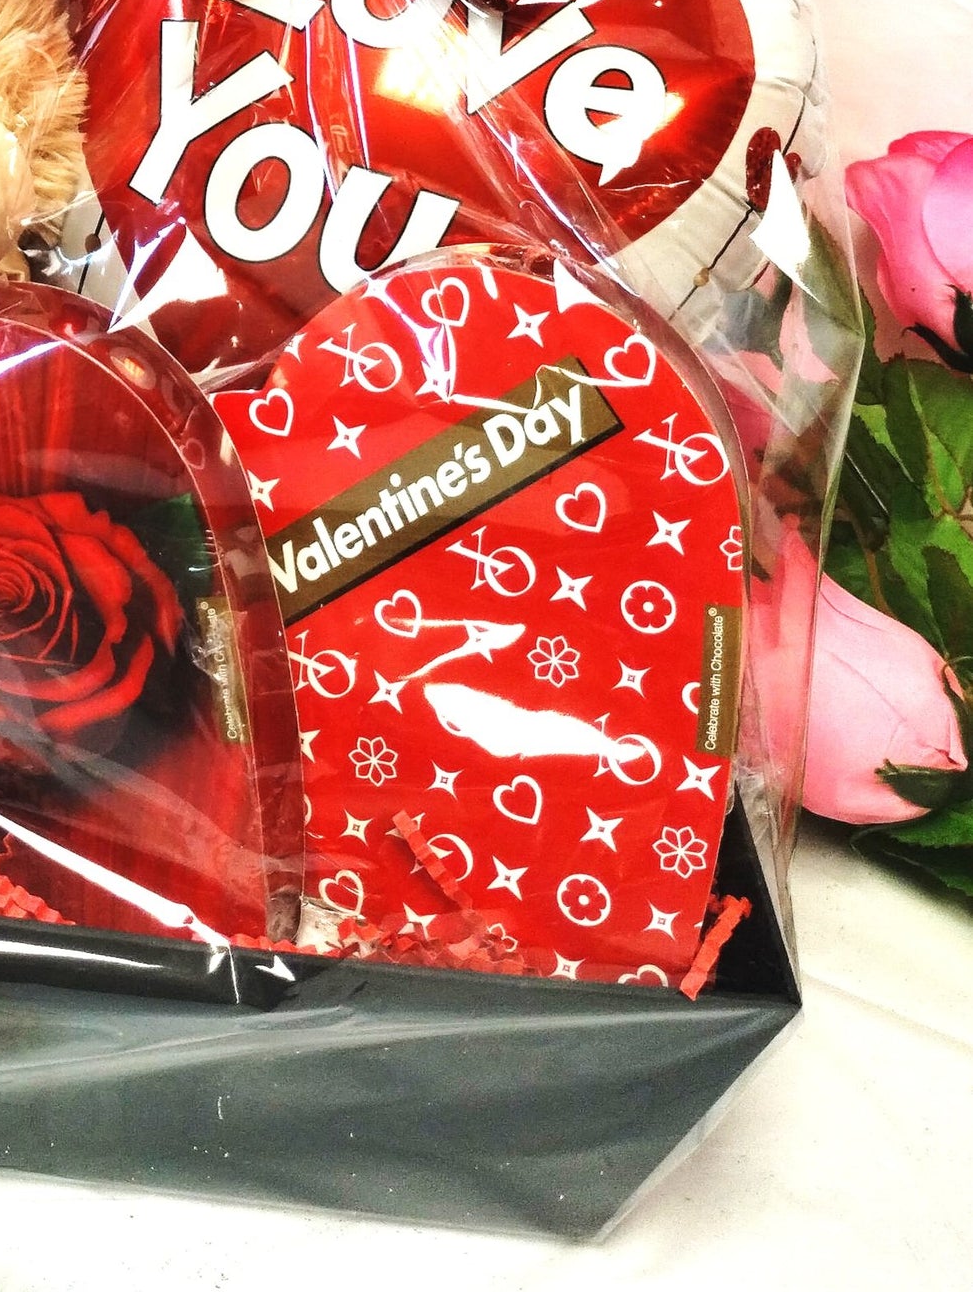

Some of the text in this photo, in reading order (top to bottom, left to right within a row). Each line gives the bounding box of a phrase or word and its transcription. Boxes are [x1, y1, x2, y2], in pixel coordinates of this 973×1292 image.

[129, 19, 460, 295] You
[268, 385, 587, 594] Valentine's Day
[705, 698, 720, 750] Celebrate
[710, 673, 722, 696] with
